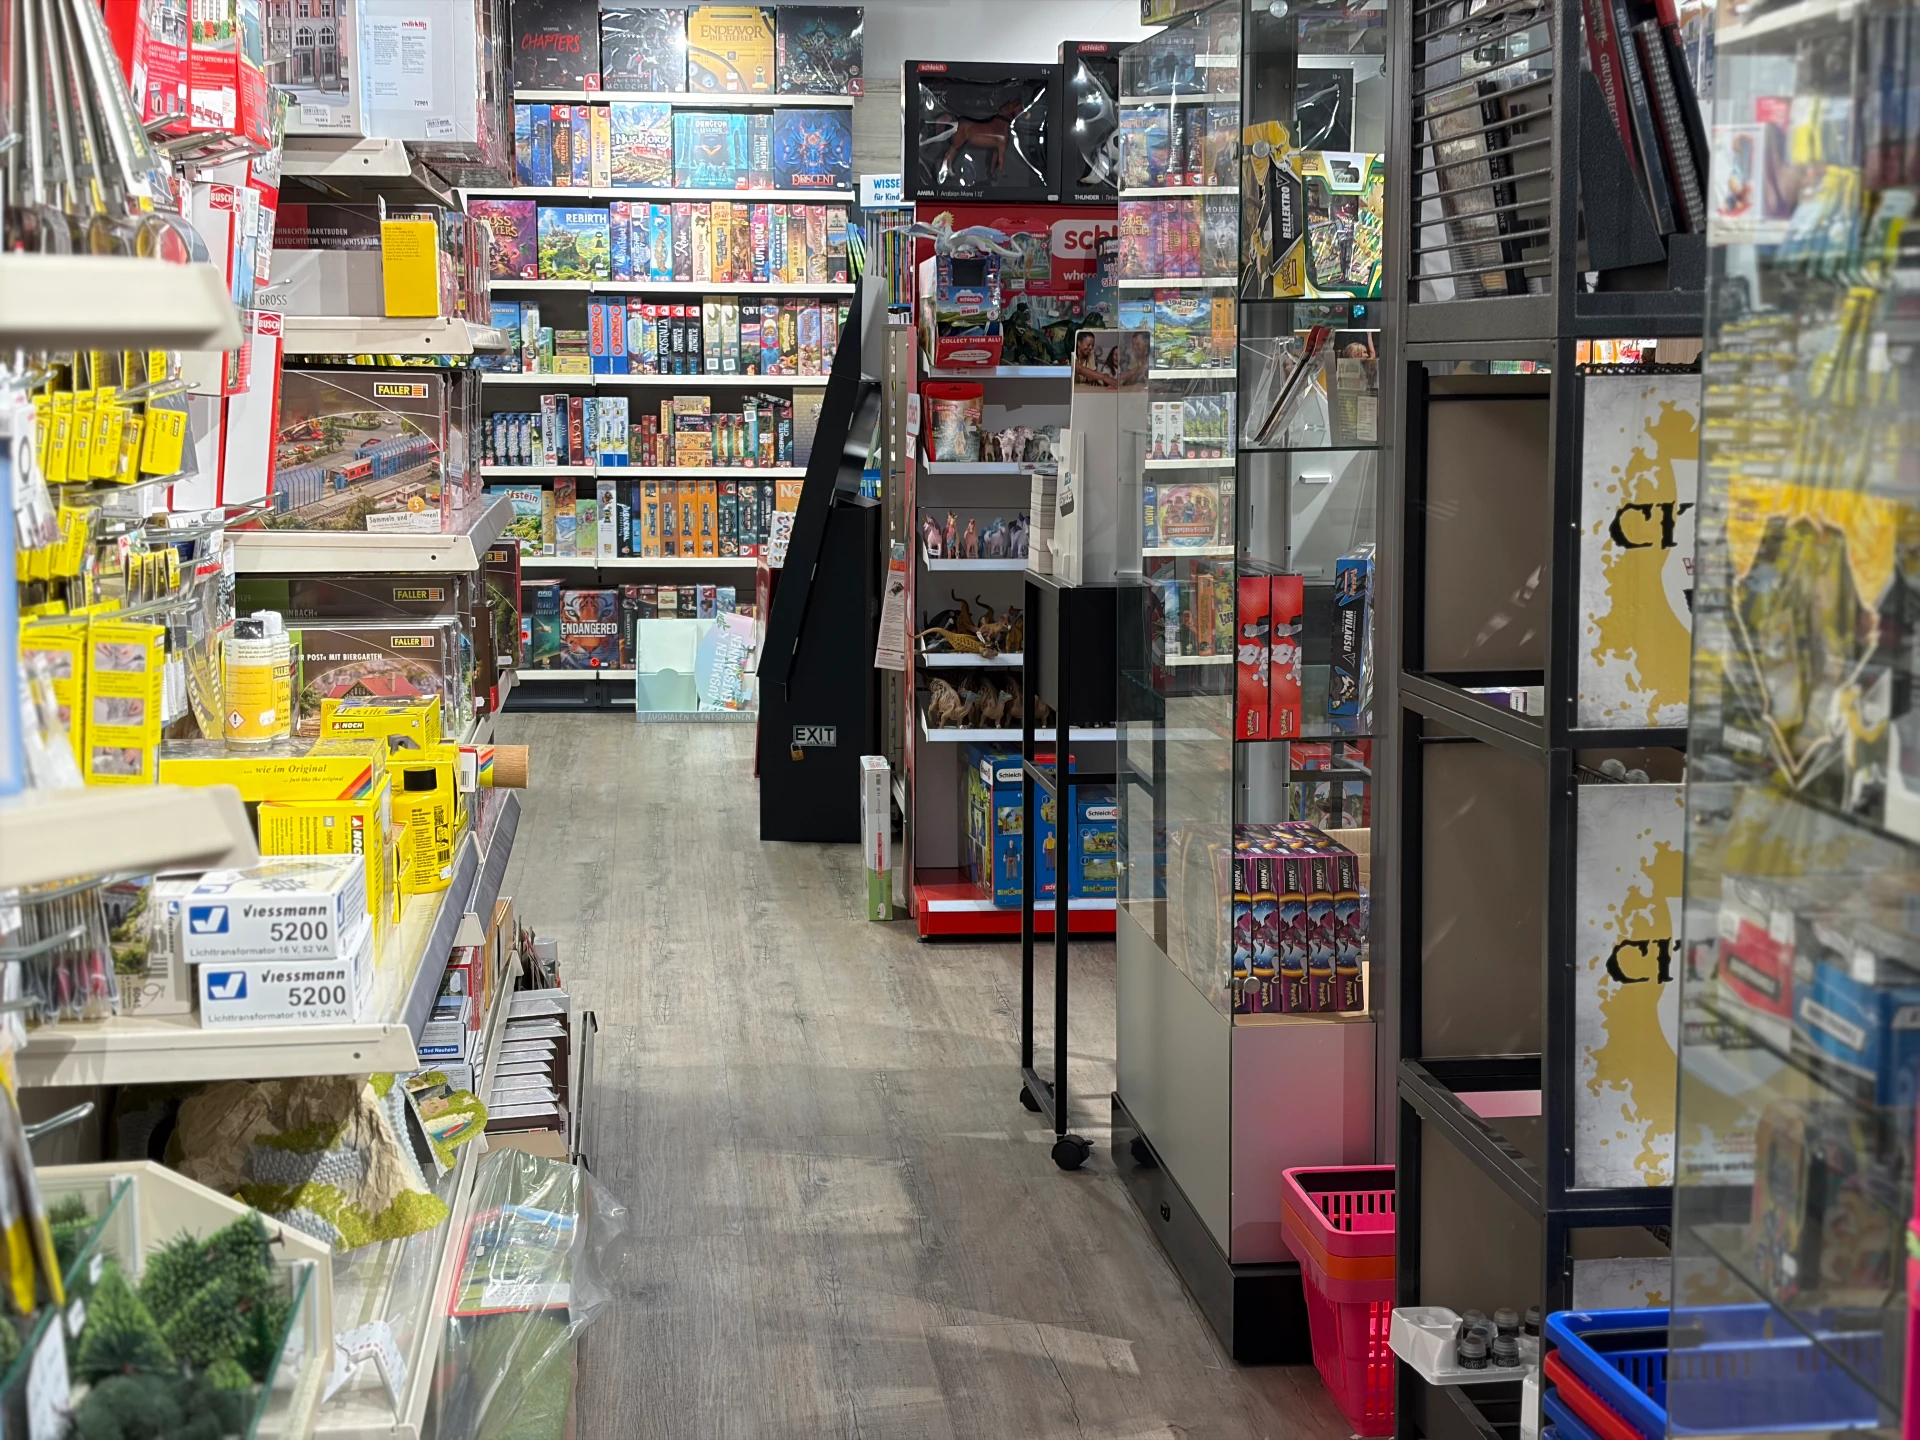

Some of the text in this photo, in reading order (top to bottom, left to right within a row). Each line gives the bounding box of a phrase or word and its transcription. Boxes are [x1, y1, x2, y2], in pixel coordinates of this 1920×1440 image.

[700, 25, 766, 39] ENDEAVOR
[521, 33, 581, 53] CHAPTERS
[791, 174, 836, 186] DESCENT
[873, 179, 901, 189] WISSE
[210, 191, 234, 204] BUSCH
[873, 193, 900, 201] für Kind
[565, 213, 607, 223] REBIRTH
[1281, 186, 1292, 239] BELLEKTRO
[480, 215, 512, 226] BOSS
[259, 294, 288, 306] GROSS
[258, 319, 280, 330] BUSCH
[590, 304, 604, 356] ORONGO
[610, 305, 623, 356] ORONGO
[378, 385, 410, 395] FALLER
[397, 591, 427, 599] FALLER
[561, 622, 618, 635] ENDANGERED
[1343, 610, 1354, 652] WULAOSU
[394, 638, 420, 646] FALLER
[329, 653, 341, 661] MIT
[343, 653, 383, 661] BIERGARTEN
[707, 642, 729, 700] AUSMALEN
[720, 634, 743, 702] ENTSPANNEN
[647, 713, 690, 721] AUSMALEN
[700, 713, 752, 721] ENTSPANNEN
[341, 722, 363, 730] NOCH
[795, 727, 834, 744] EXIT
[256, 763, 327, 774] wie im Original
[322, 776, 344, 784] original
[243, 905, 327, 918] Viessmann
[270, 921, 328, 942] 5200
[190, 945, 276, 957] Lichttransformator
[279, 946, 288, 954] 16
[303, 945, 313, 953] 52
[316, 945, 329, 953] VA
[261, 969, 345, 983] Viessmann
[288, 985, 346, 1006] 5200
[208, 1011, 294, 1023] Lichttransformator
[297, 1011, 307, 1019] 16
[321, 1010, 332, 1018] 52
[334, 1009, 347, 1017] VA
